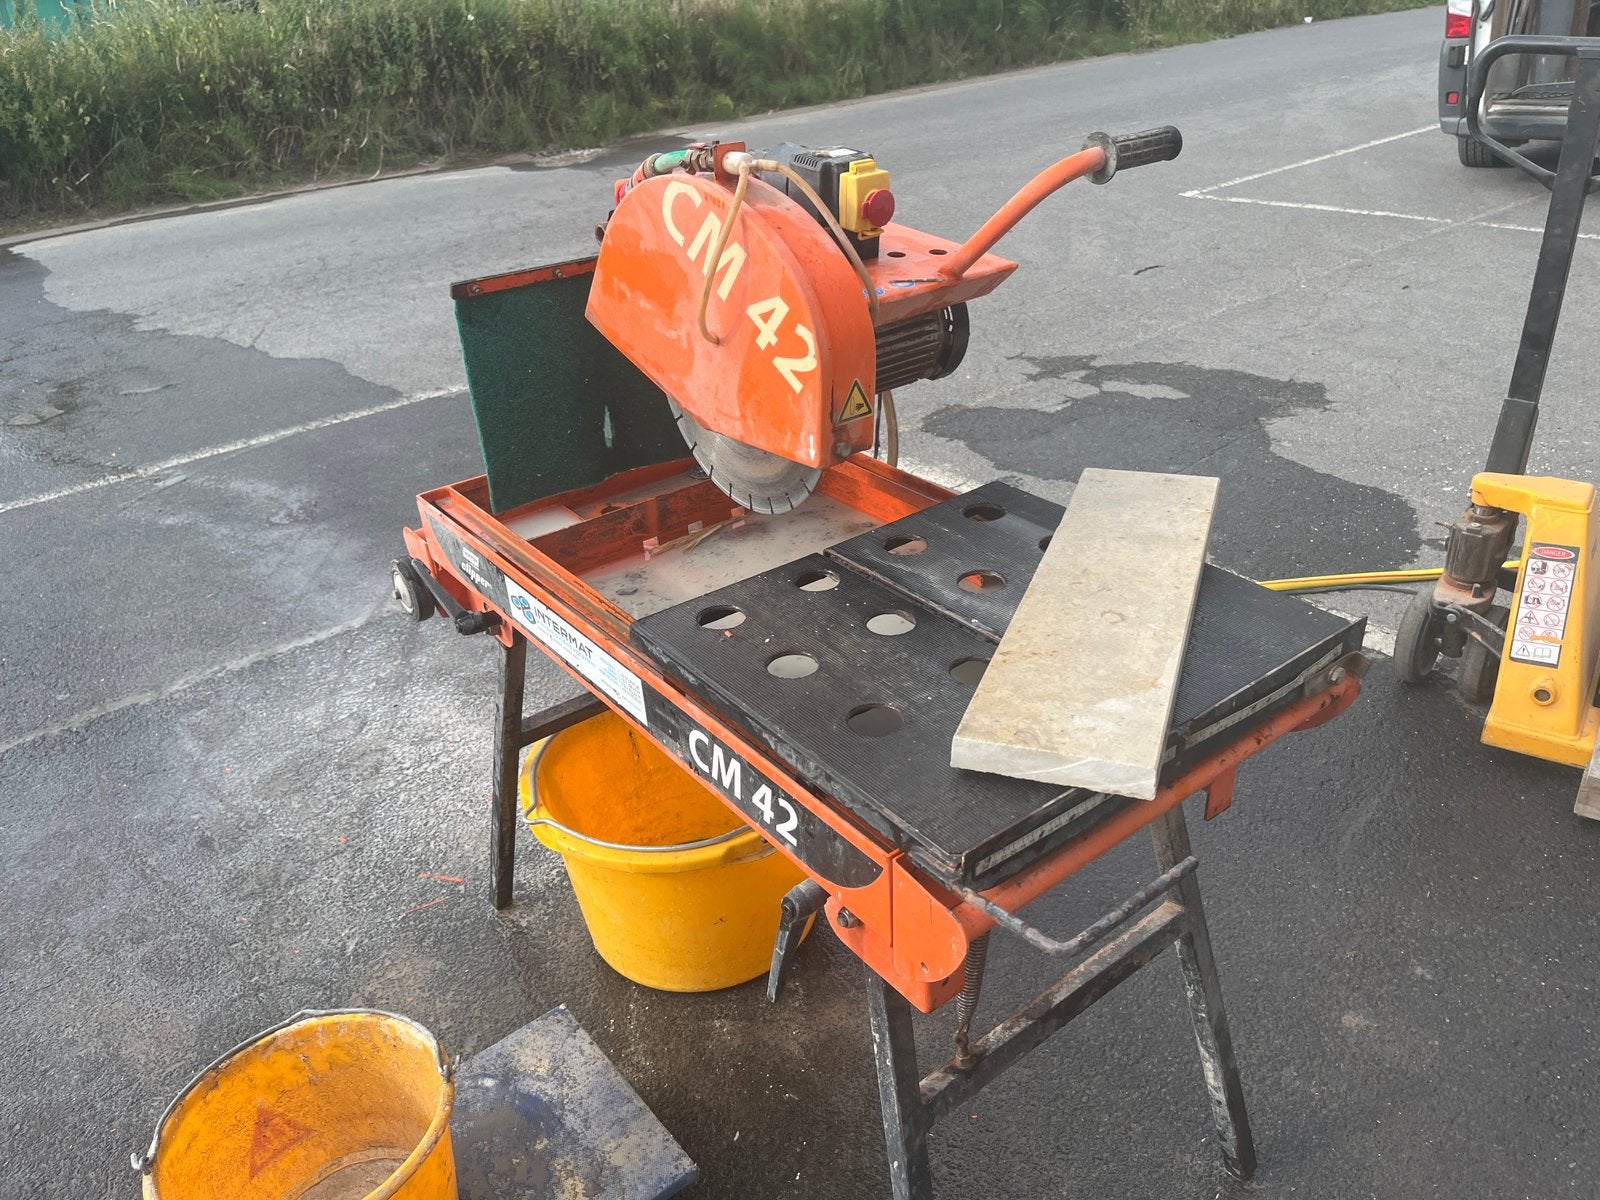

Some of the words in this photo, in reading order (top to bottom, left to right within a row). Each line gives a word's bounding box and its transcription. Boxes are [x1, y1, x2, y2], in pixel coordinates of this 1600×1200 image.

[662, 181, 747, 302] CM
[746, 296, 818, 394] 42
[461, 561, 493, 589] clipper
[1541, 549, 1566, 557] DANGER
[534, 606, 593, 659] INTERMAT
[688, 729, 742, 800] CM
[751, 783, 799, 847] 42
